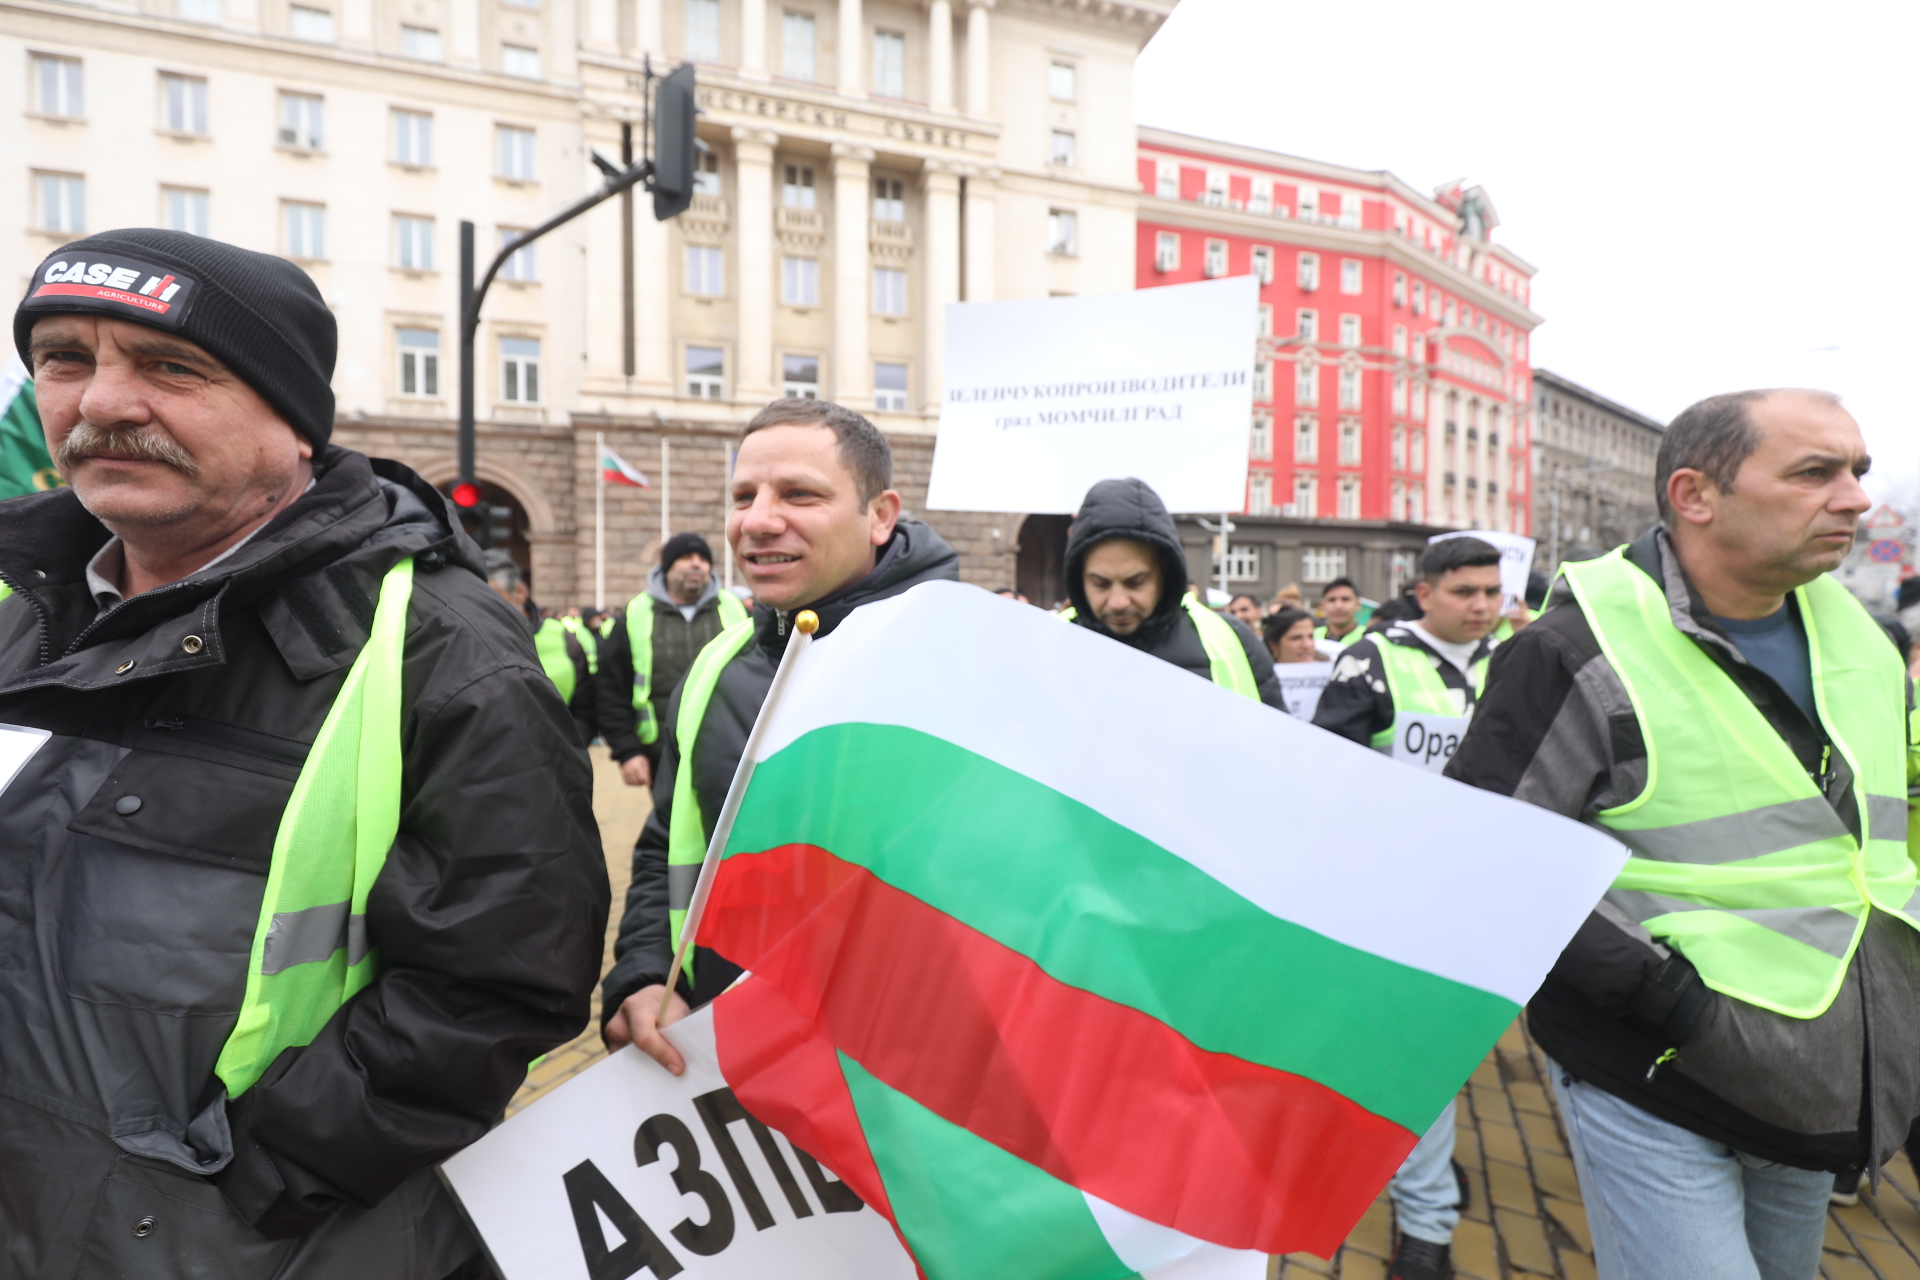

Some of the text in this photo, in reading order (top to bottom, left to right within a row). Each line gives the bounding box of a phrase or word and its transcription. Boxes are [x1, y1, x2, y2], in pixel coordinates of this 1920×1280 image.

[625, 78, 969, 147] МИСТЕРСКИ СЪВЕТ
[44, 260, 141, 290] CASE
[96, 289, 164, 311] AGRICULTURE
[949, 370, 1246, 404] ЗЕЛЕНЧУКОПРОИЗВОДИТЕЛИ
[995, 404, 1185, 432] град МОМЧИЛГРАД
